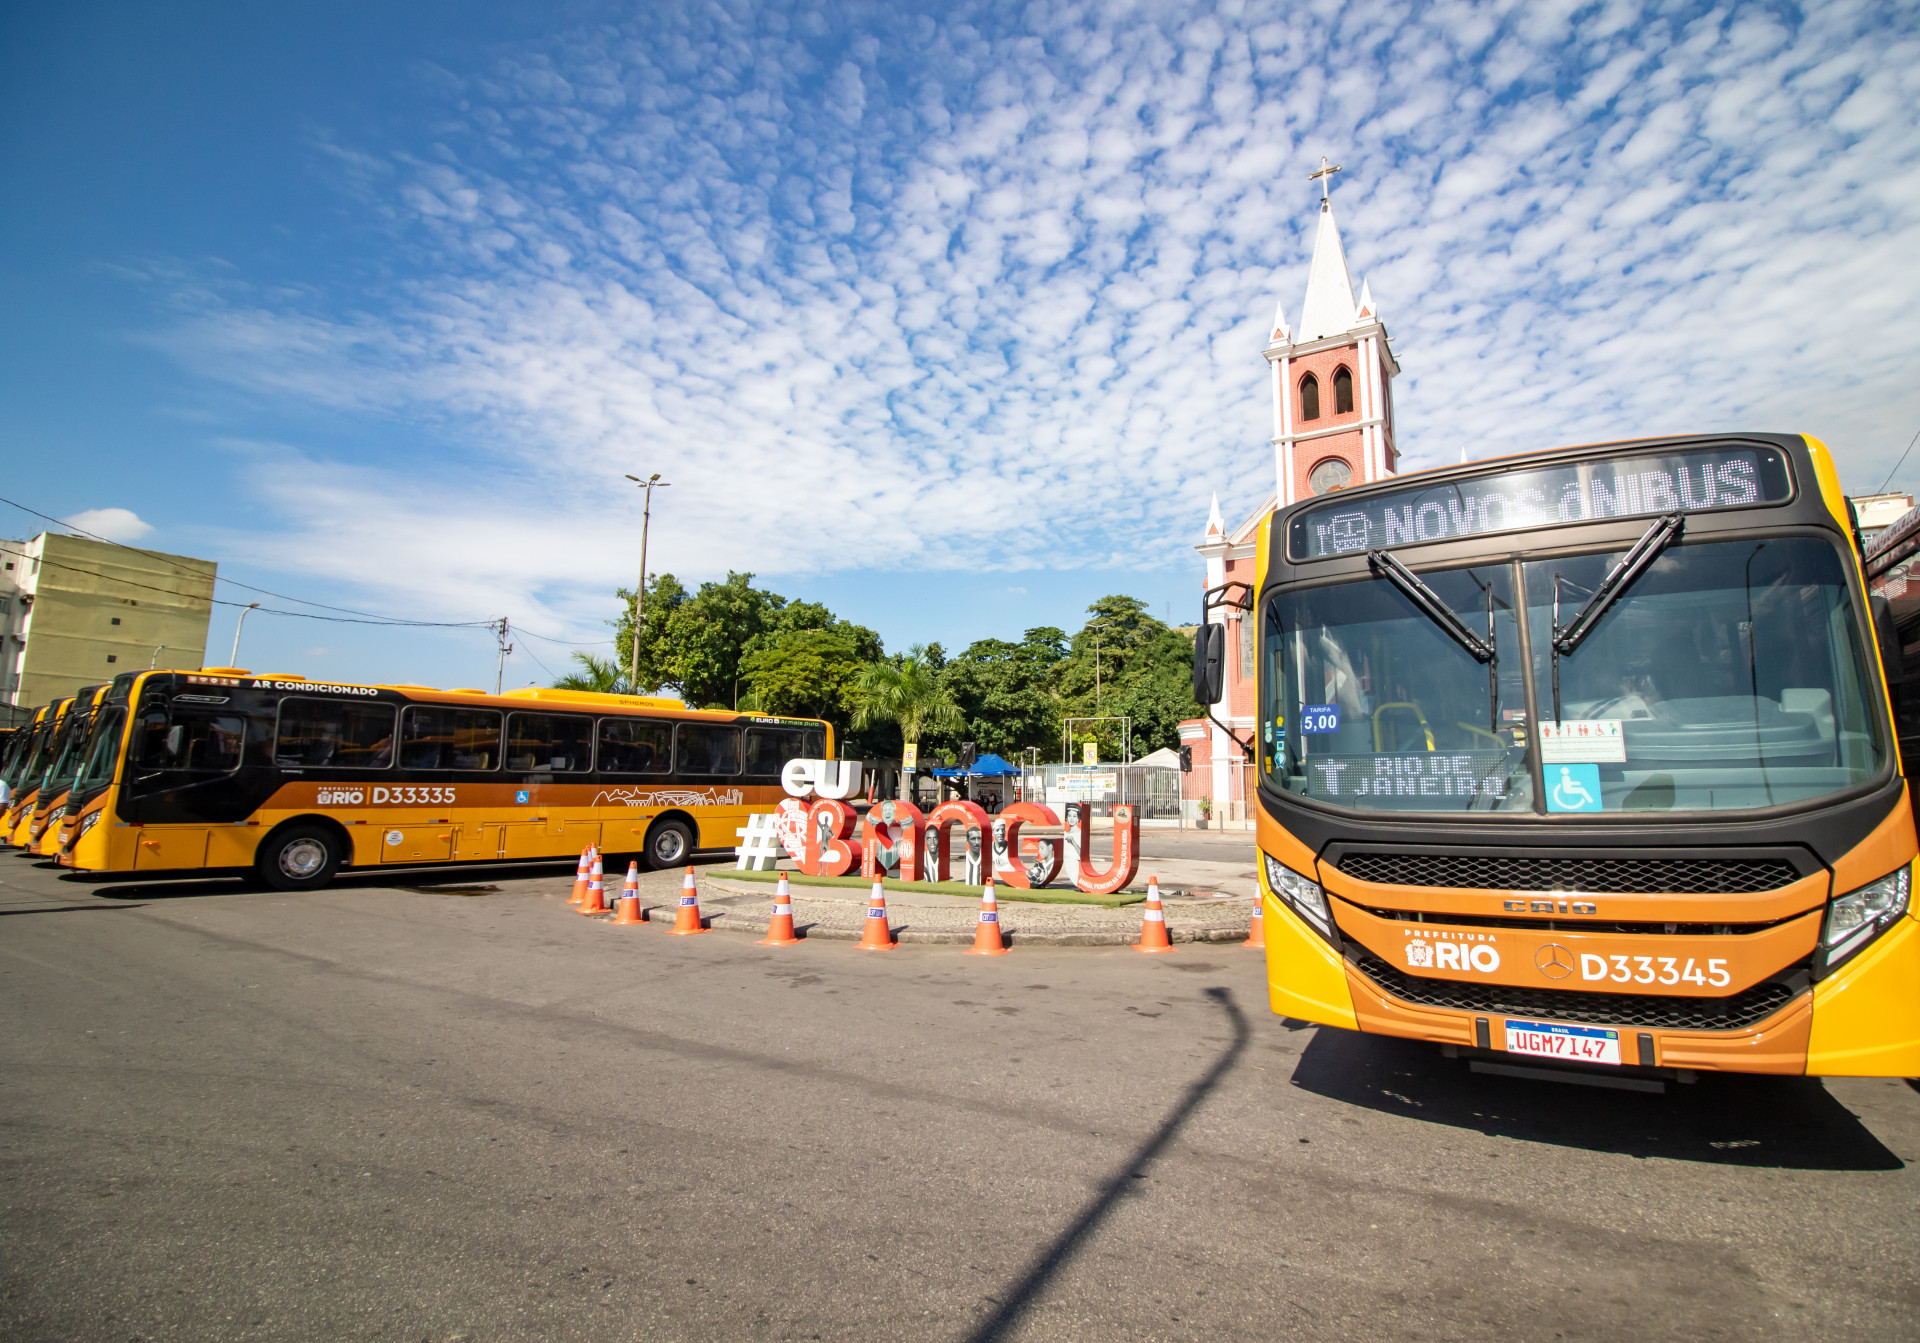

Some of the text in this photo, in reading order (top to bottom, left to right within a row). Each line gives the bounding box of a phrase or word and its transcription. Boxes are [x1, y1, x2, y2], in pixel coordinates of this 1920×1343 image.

[1384, 487, 1546, 546] NOVOS
[252, 680, 379, 696] AR CONDICIONADO
[1304, 714, 1337, 732] 5,00
[1374, 755, 1473, 775] RIO DE
[1353, 776, 1504, 796] JANEIRO
[332, 787, 456, 804] RIO D33335
[1503, 900, 1597, 915] CAIO
[1404, 929, 1496, 942] PREFEITURA
[1435, 942, 1731, 987] RIO D33345
